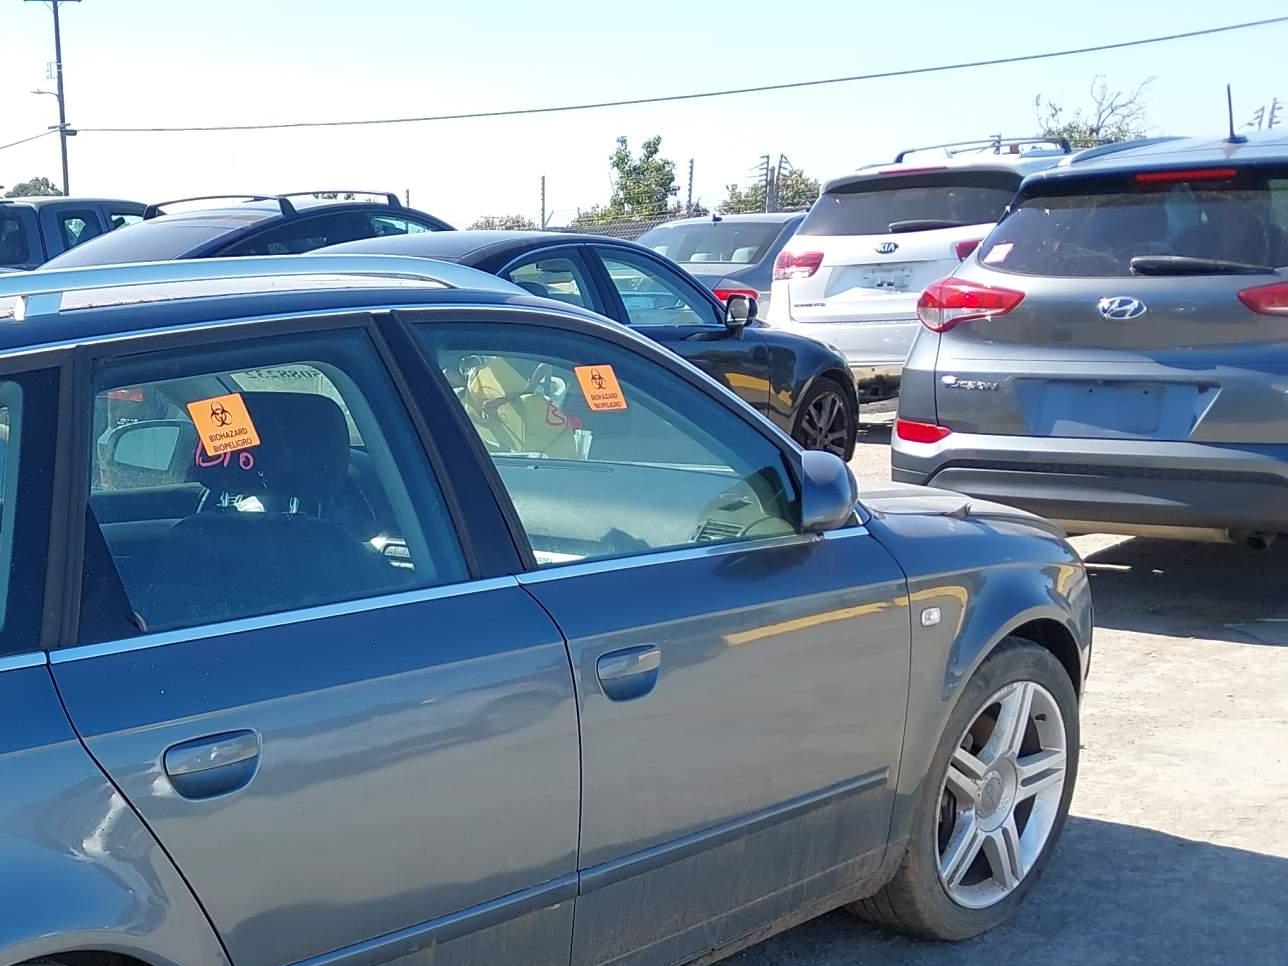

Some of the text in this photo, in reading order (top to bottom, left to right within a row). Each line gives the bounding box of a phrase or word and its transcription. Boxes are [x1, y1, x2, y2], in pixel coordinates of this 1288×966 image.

[877, 242, 897, 252] KIA
[208, 427, 248, 443] BIOHAZARD
[212, 438, 253, 453] BIOPELIGRO
